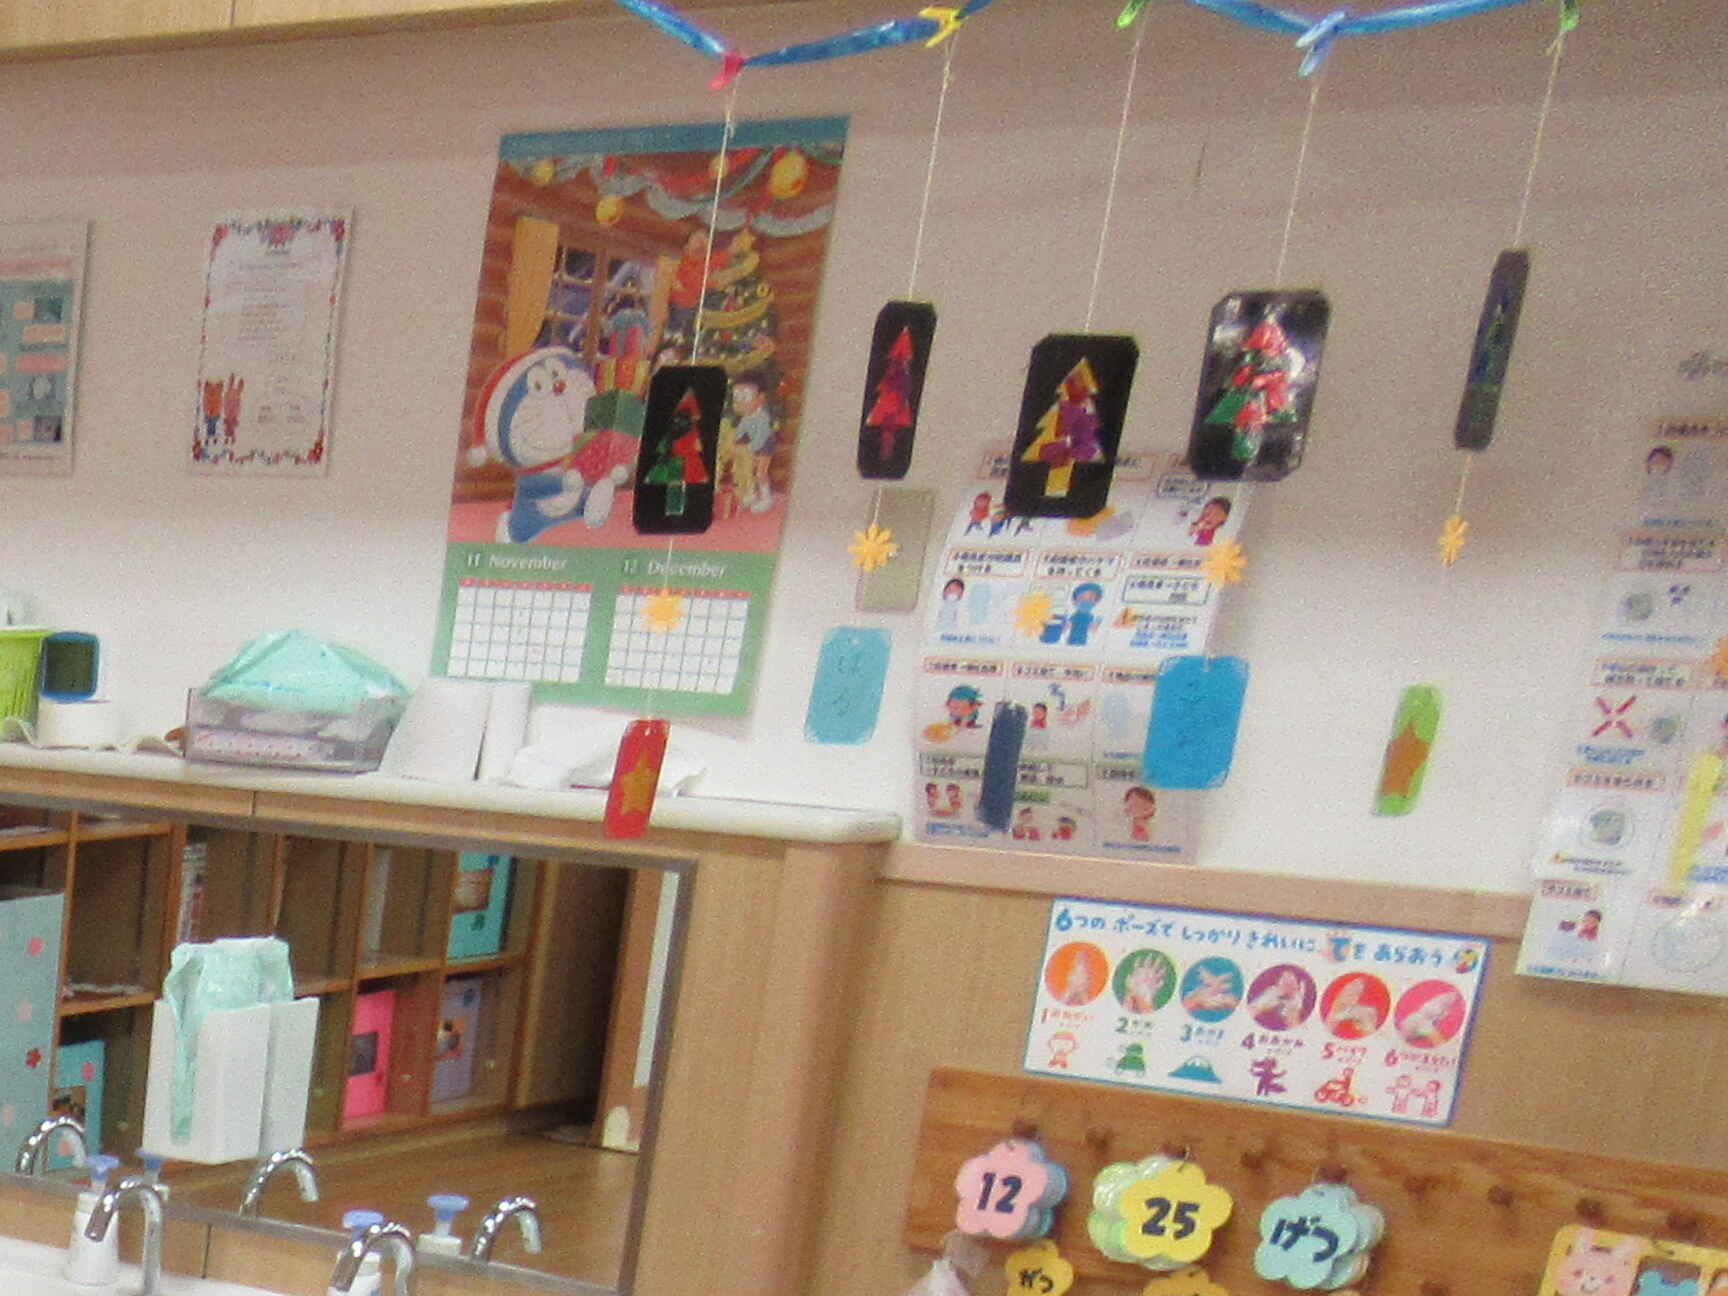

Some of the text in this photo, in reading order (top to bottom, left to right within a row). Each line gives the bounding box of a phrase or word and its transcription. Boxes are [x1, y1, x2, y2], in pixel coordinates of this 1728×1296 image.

[490, 554, 567, 571] November
[648, 560, 725, 578] December
[1056, 909, 1105, 931] 6つの
[1113, 918, 1174, 939] ポーズで
[1181, 923, 1240, 944] しっかり
[977, 1172, 1023, 1214] 12
[1142, 1196, 1200, 1240] 25
[1269, 1215, 1340, 1263] げつ
[1018, 1268, 1054, 1293] がつ
